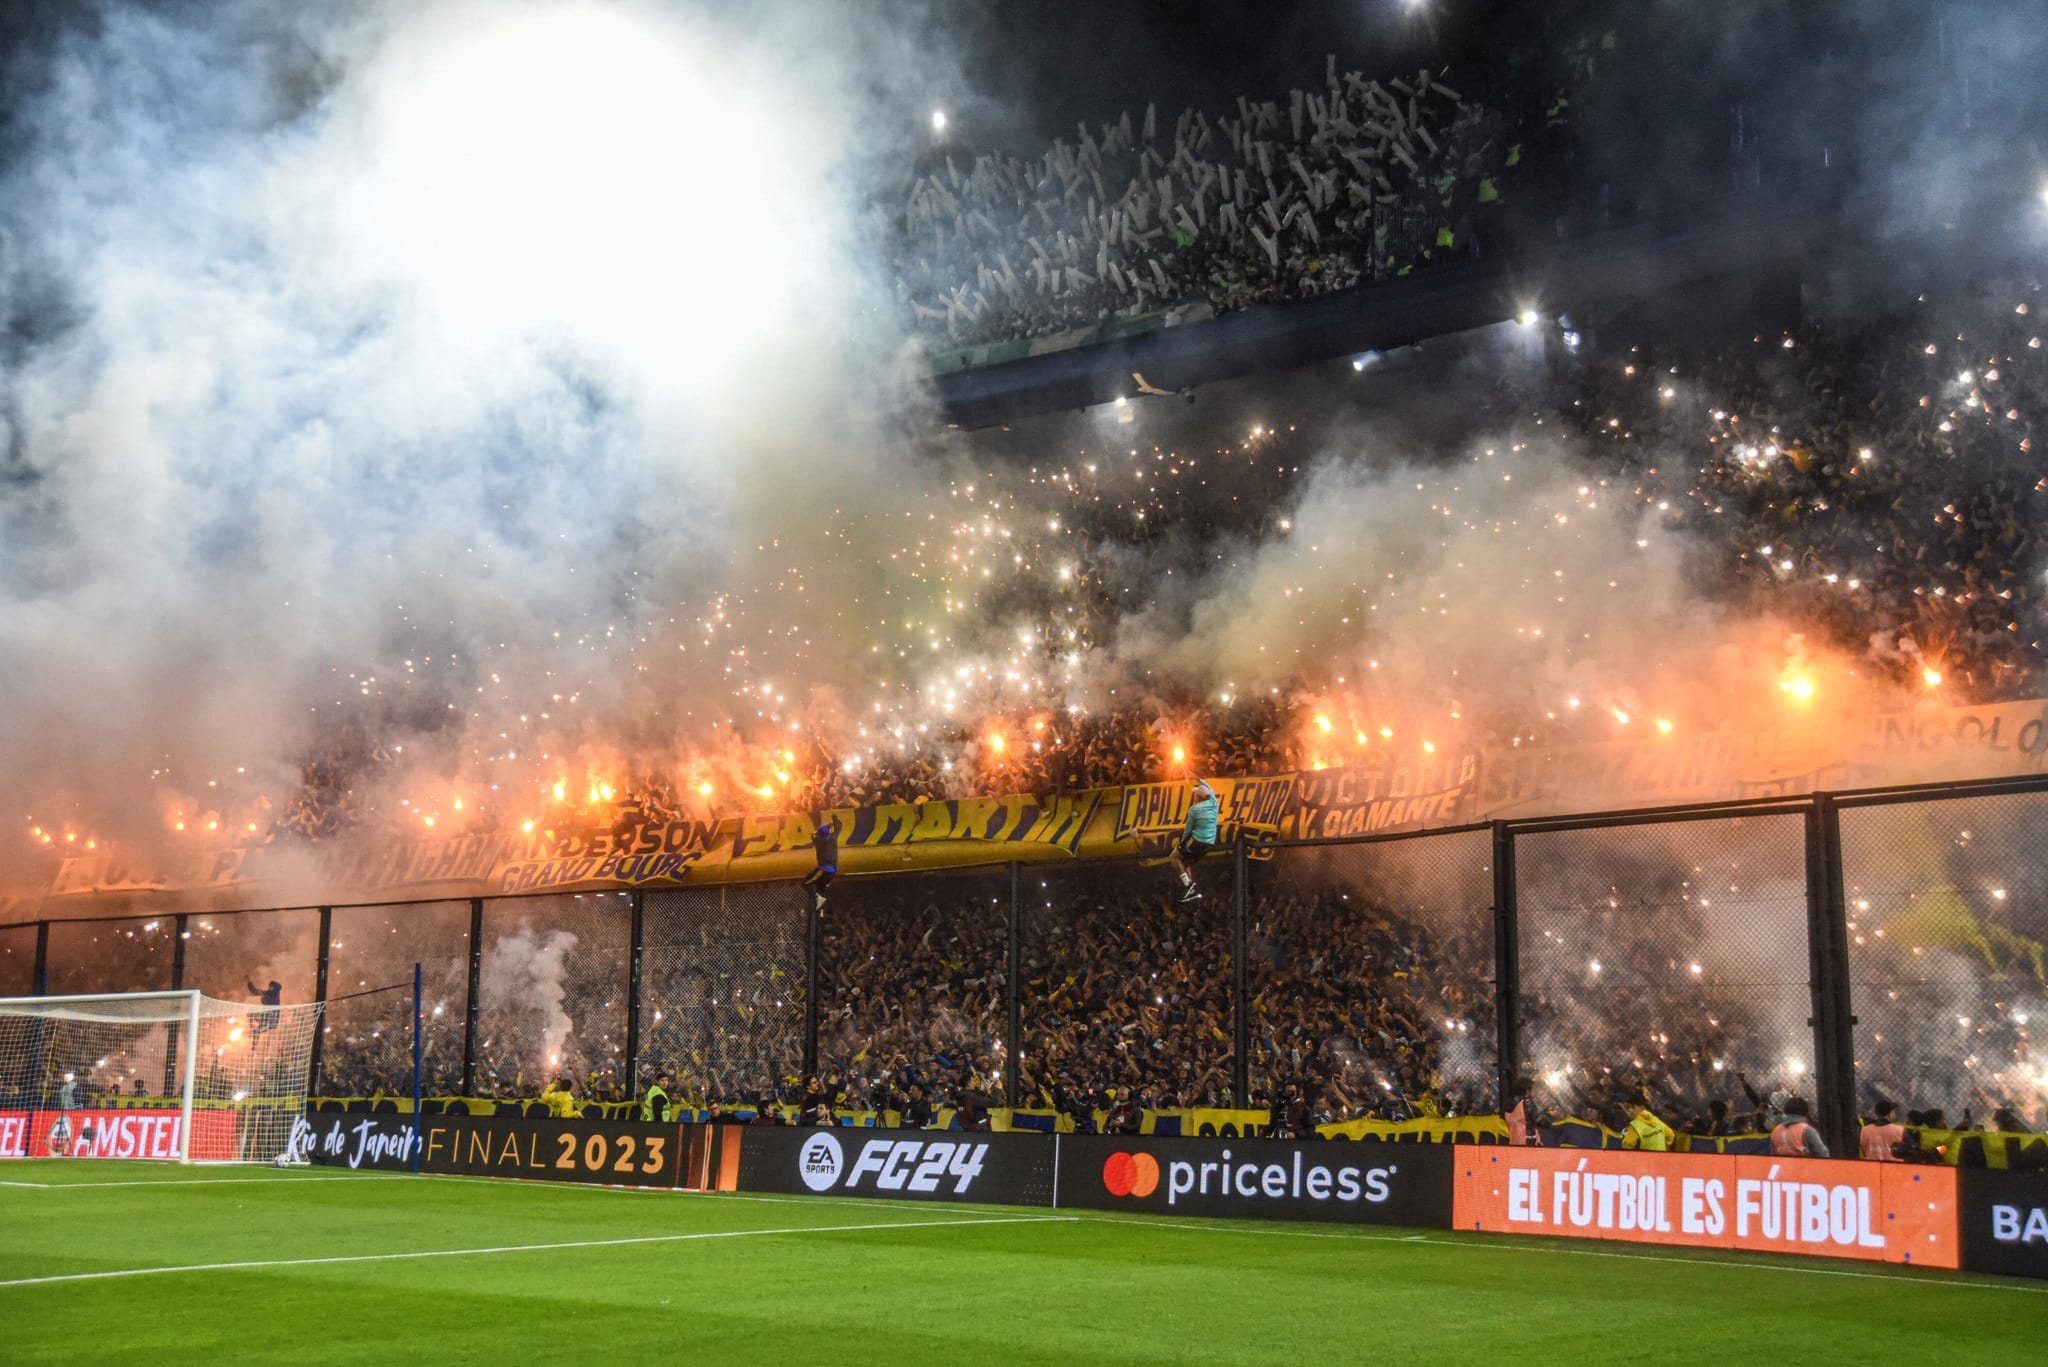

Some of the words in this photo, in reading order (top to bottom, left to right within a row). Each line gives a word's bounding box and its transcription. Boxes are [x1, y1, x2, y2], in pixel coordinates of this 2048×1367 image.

[1119, 783, 1193, 833] CAPILL
[1322, 786, 1461, 837] DIAMANTE
[502, 858, 597, 892] GRAND
[593, 851, 702, 882] BOURG
[0, 1117, 27, 1156] EL
[73, 1115, 182, 1157] AMSTEL
[286, 1114, 317, 1162] Rio
[324, 1120, 345, 1156] de
[427, 1128, 545, 1168] FINAL
[556, 1132, 665, 1174] 2023
[807, 1145, 835, 1164] EA
[805, 1165, 835, 1174] SPORTS
[1508, 1168, 1543, 1222] EL
[1553, 1158, 1671, 1232] FÚTBOL
[1681, 1177, 1724, 1235] ES
[1736, 1164, 1885, 1248] FÚTBOL
